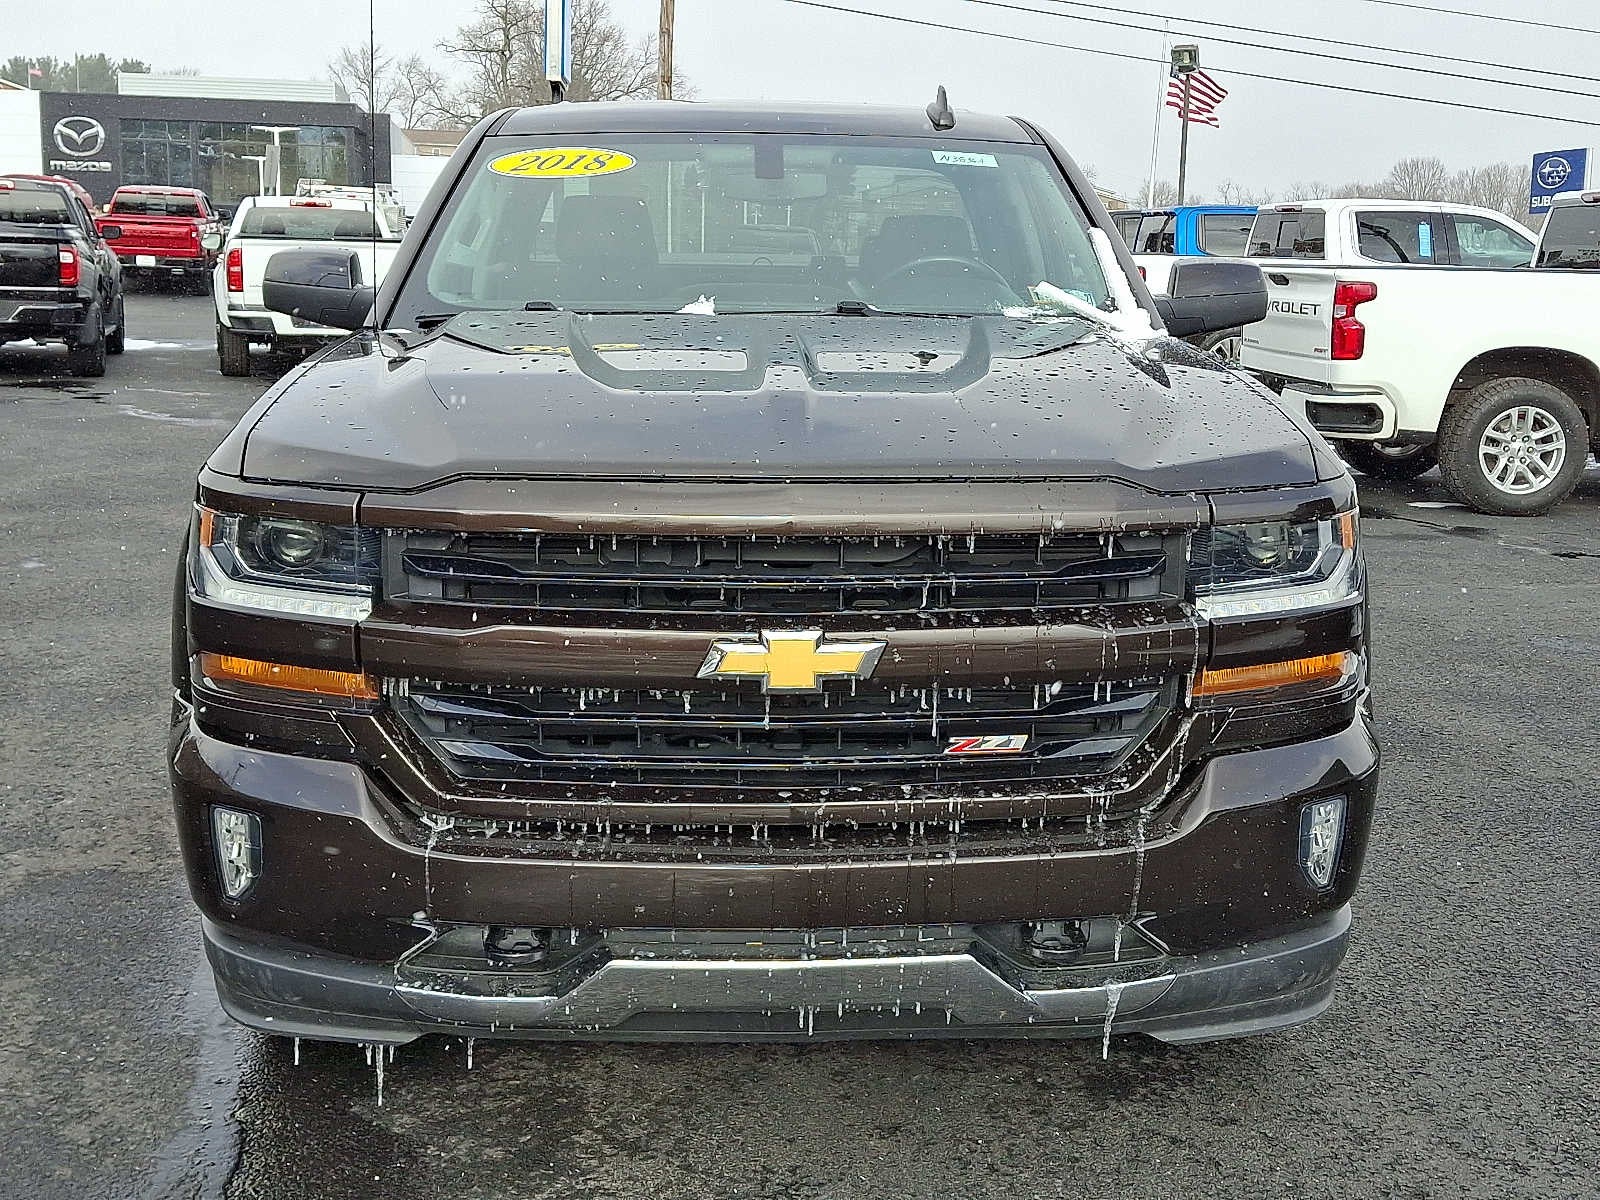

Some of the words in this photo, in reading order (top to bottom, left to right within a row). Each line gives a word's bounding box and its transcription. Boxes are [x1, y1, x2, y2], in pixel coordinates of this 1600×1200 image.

[49, 160, 112, 172] mazda
[510, 154, 615, 172] 2018
[1531, 195, 1553, 208] SUB
[943, 734, 1029, 753] Z71
